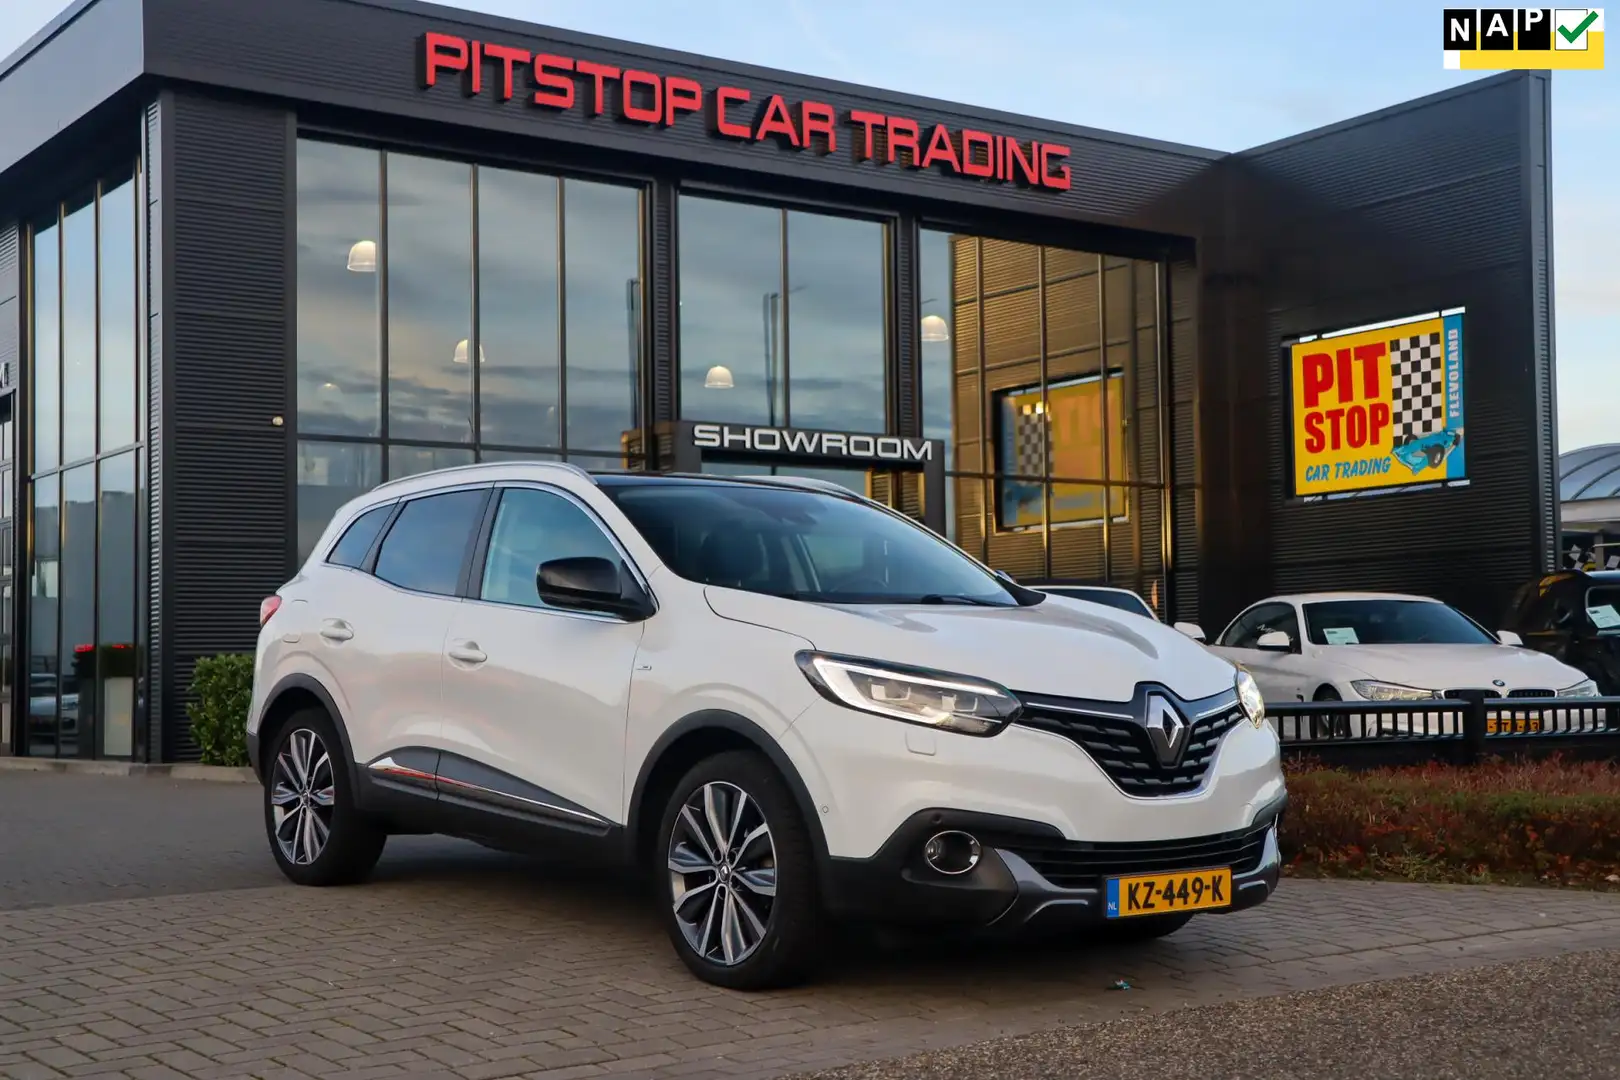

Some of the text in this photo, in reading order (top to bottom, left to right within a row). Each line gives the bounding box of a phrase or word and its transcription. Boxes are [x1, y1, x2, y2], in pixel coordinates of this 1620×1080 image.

[425, 31, 1072, 190] PITSTOP CAR TRADING
[1302, 342, 1386, 409] PIT
[1447, 328, 1461, 418] FLEVOLAND
[693, 424, 932, 461] SHOWROOM
[1304, 402, 1390, 454] STOP
[1305, 456, 1391, 482] CAR TRADING
[1107, 902, 1117, 911] NL
[1127, 875, 1224, 911] KZ-449-K
